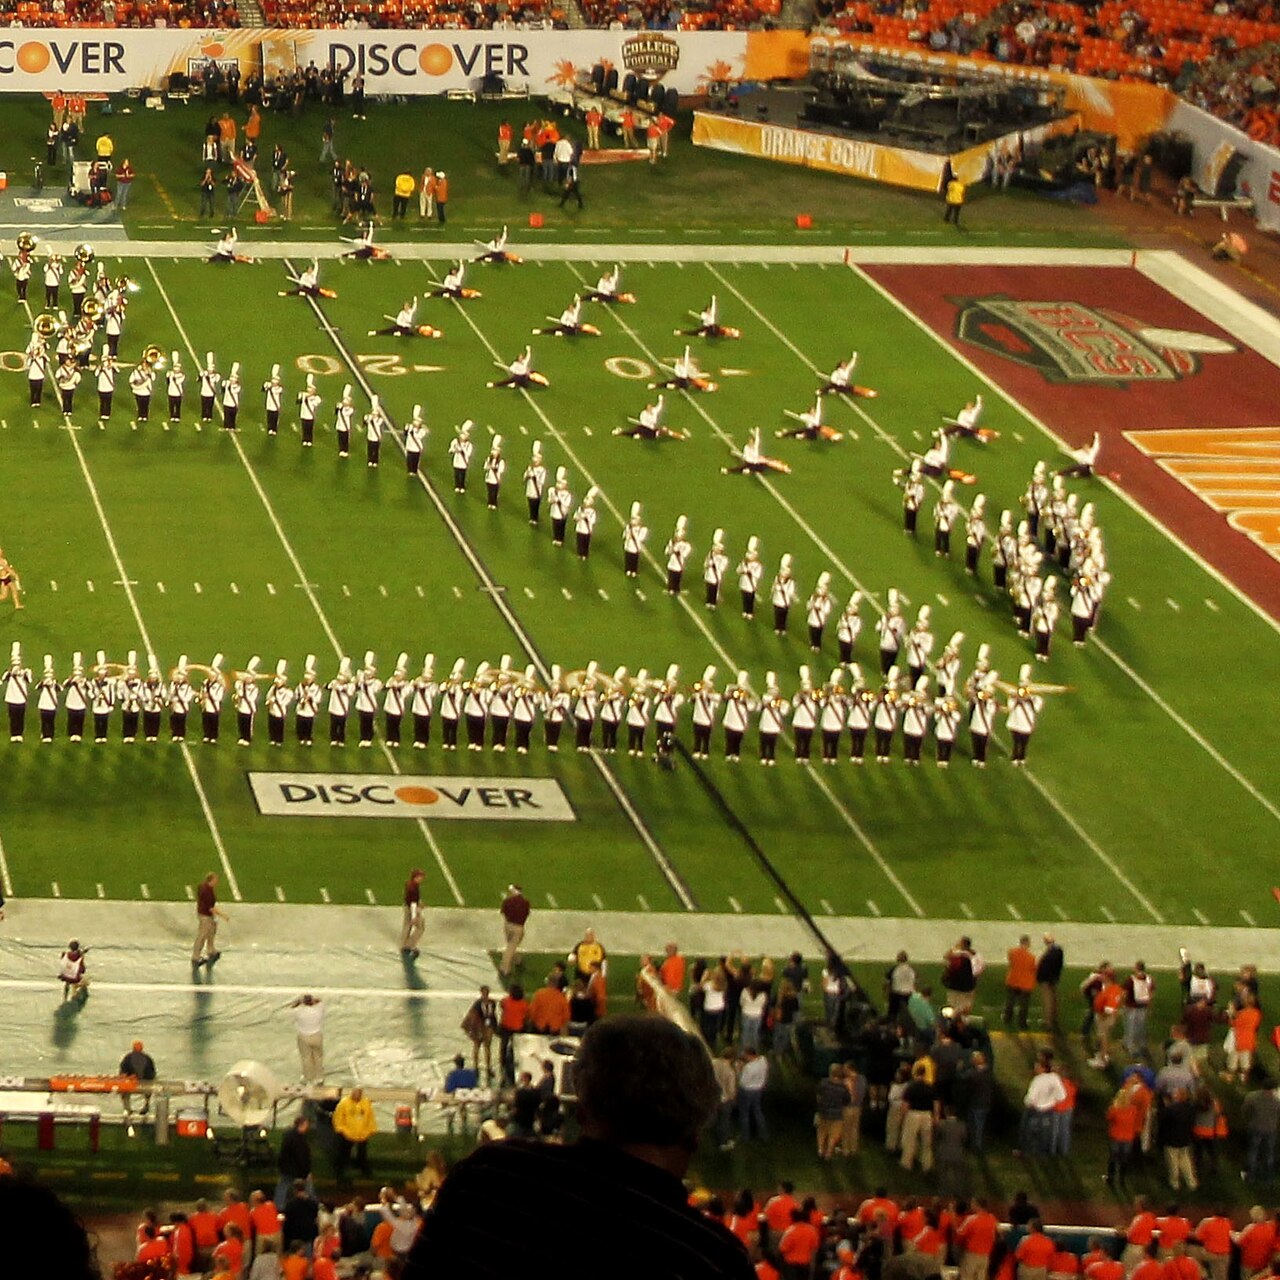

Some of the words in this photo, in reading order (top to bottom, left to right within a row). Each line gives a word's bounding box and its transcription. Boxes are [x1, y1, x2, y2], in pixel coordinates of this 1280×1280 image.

[330, 43, 529, 77] DISCOVER
[622, 41, 678, 57] COLLEGE
[624, 55, 676, 67] FOOTBALL
[761, 126, 827, 161] ORANGE
[830, 140, 878, 179] BOWL
[280, 783, 542, 809] DISCOVER
